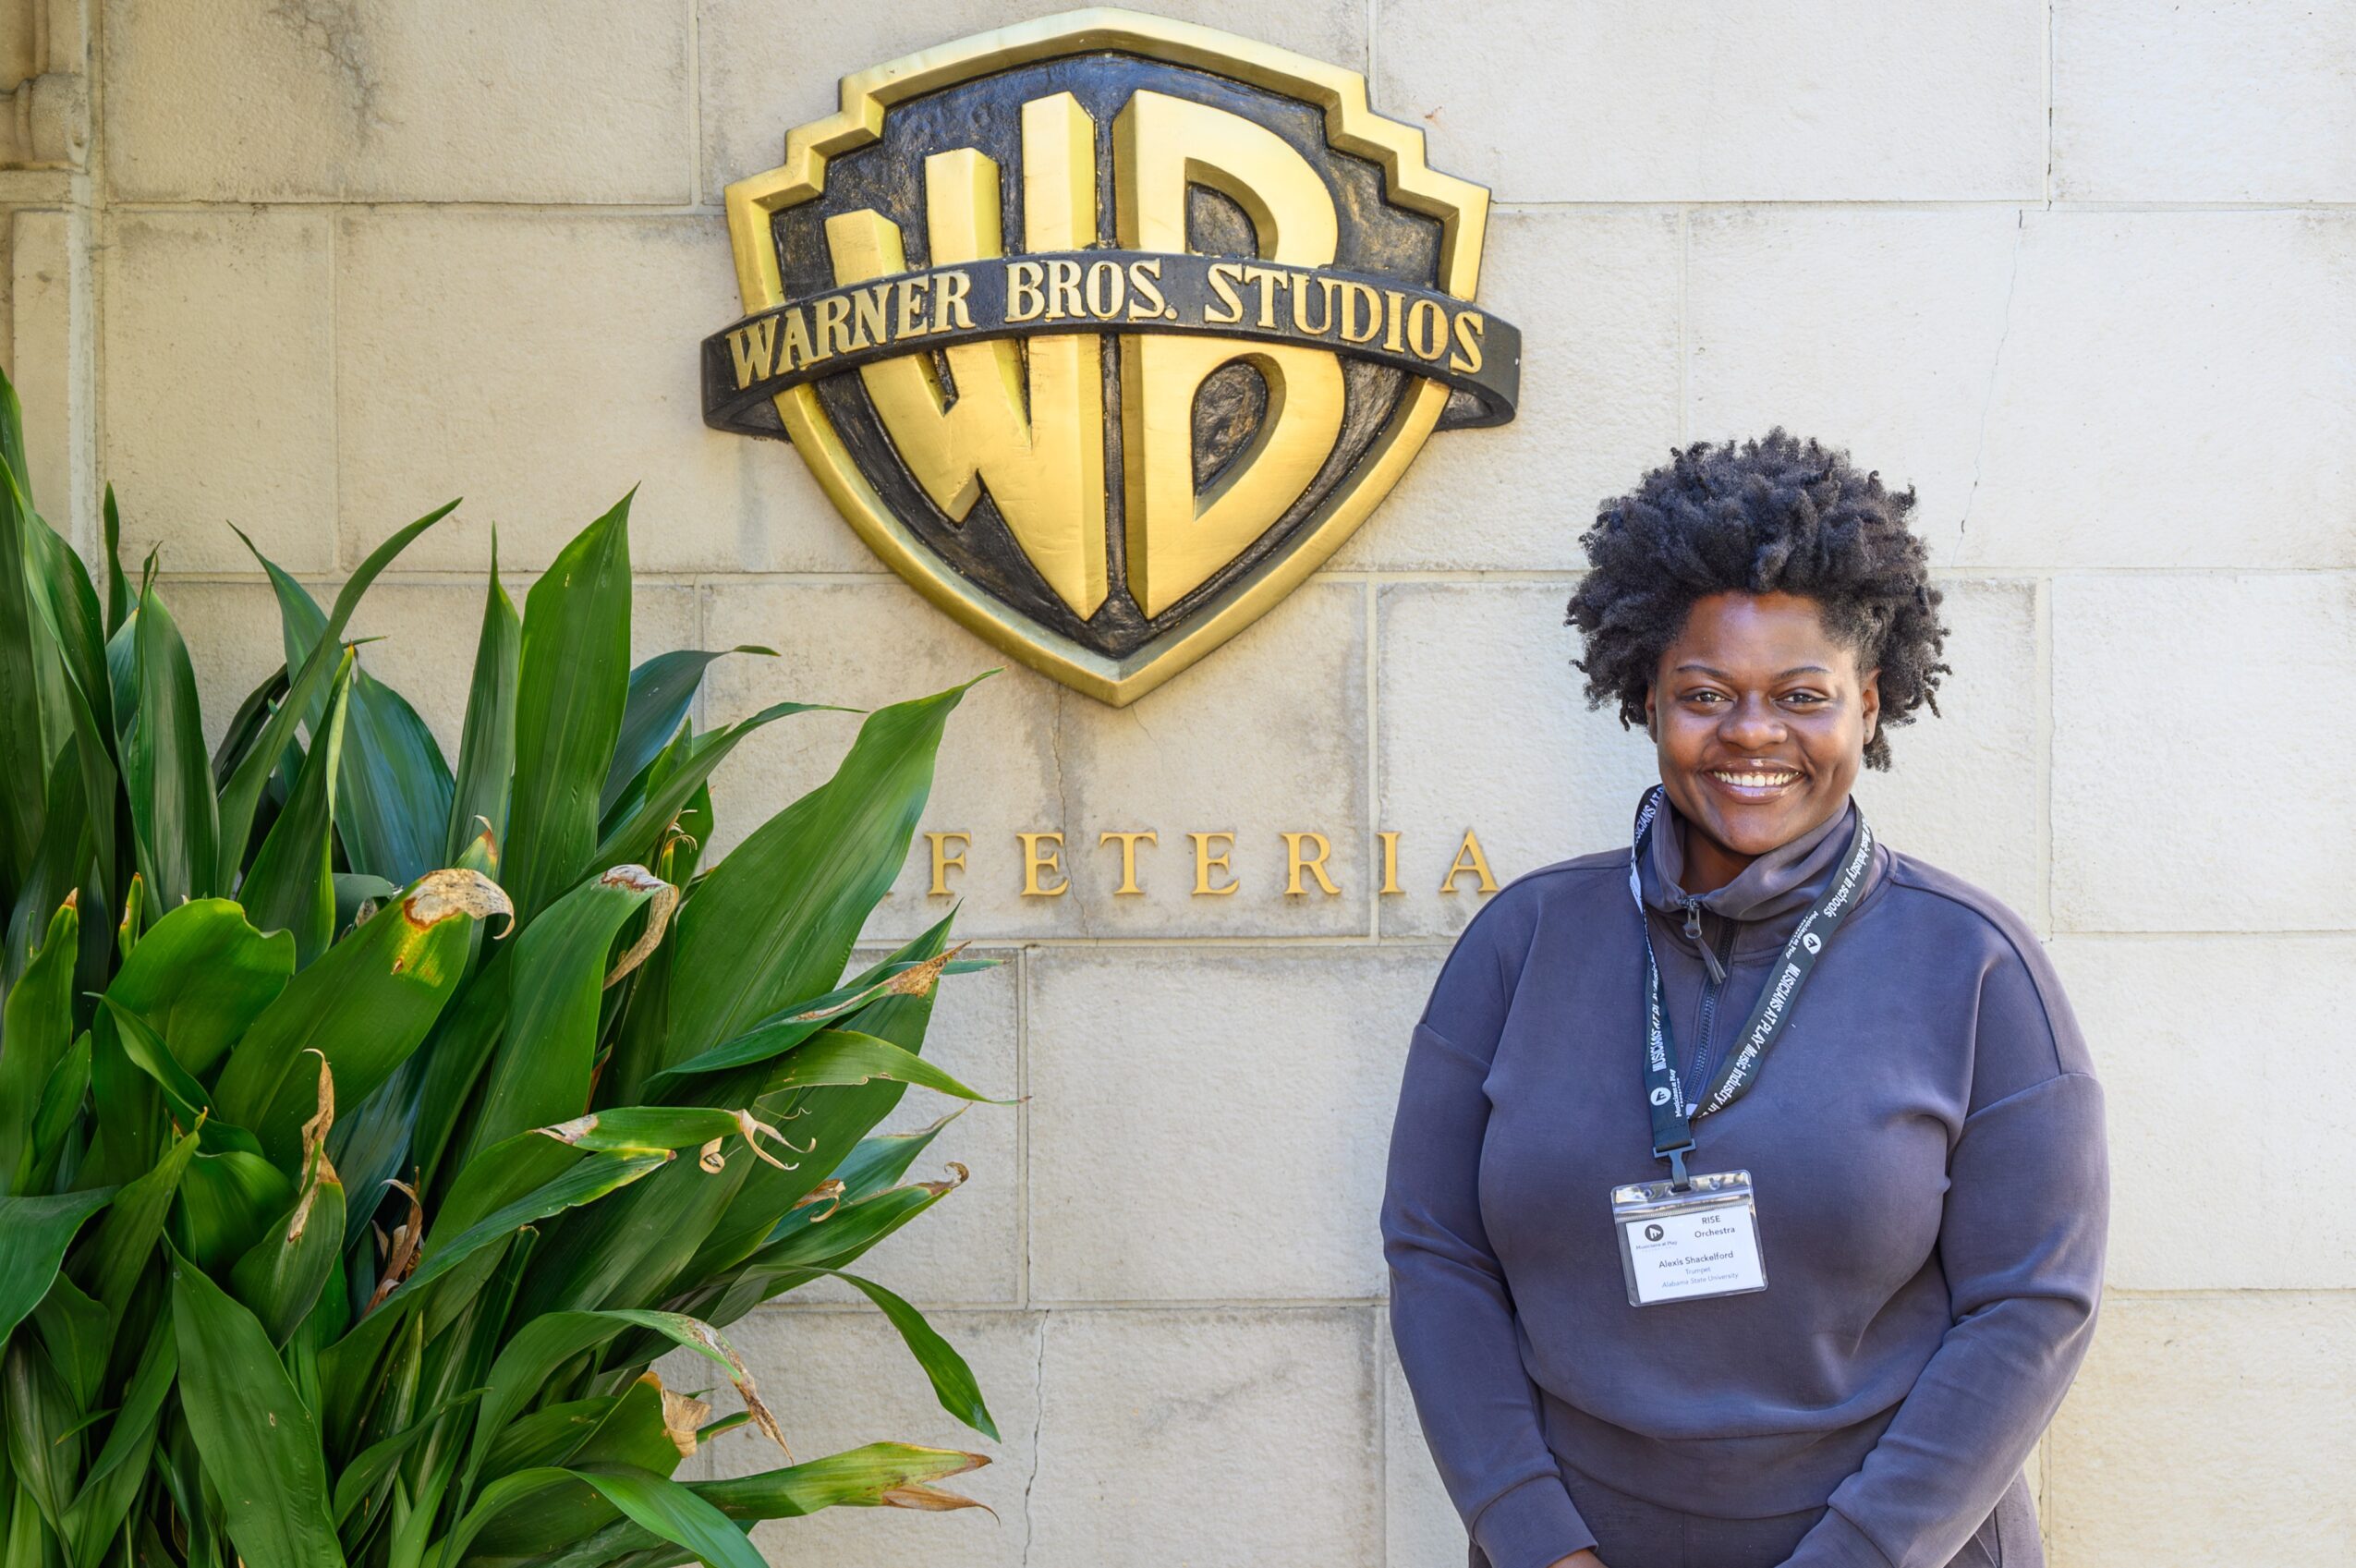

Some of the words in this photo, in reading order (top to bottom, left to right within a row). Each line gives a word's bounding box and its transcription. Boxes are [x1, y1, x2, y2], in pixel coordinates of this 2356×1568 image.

[725, 271, 976, 390] WARNER
[1004, 259, 1176, 323] BROS.
[1204, 262, 1484, 374] STUDIOS
[824, 90, 1346, 621] WB
[885, 829, 1500, 896] FETERIA
[1846, 847, 1869, 881] Industry
[1823, 884, 1849, 918] schools
[1769, 962, 1802, 1013] MUSICIANS
[1652, 1014, 1661, 1029] AT
[1763, 1006, 1779, 1025] AT
[1750, 1018, 1773, 1050] PLAY
[1735, 1043, 1758, 1070] Music
[1714, 1066, 1747, 1106] Industry
[1694, 1226, 1736, 1239] Orchestra
[1701, 1215, 1721, 1225] RISE
[1658, 1258, 1683, 1269] Alexis
[1684, 1250, 1734, 1265] Shackelford
[1684, 1266, 1711, 1275] Trumpet
[1661, 1279, 1689, 1288] Alabama
[1707, 1272, 1739, 1282] University
